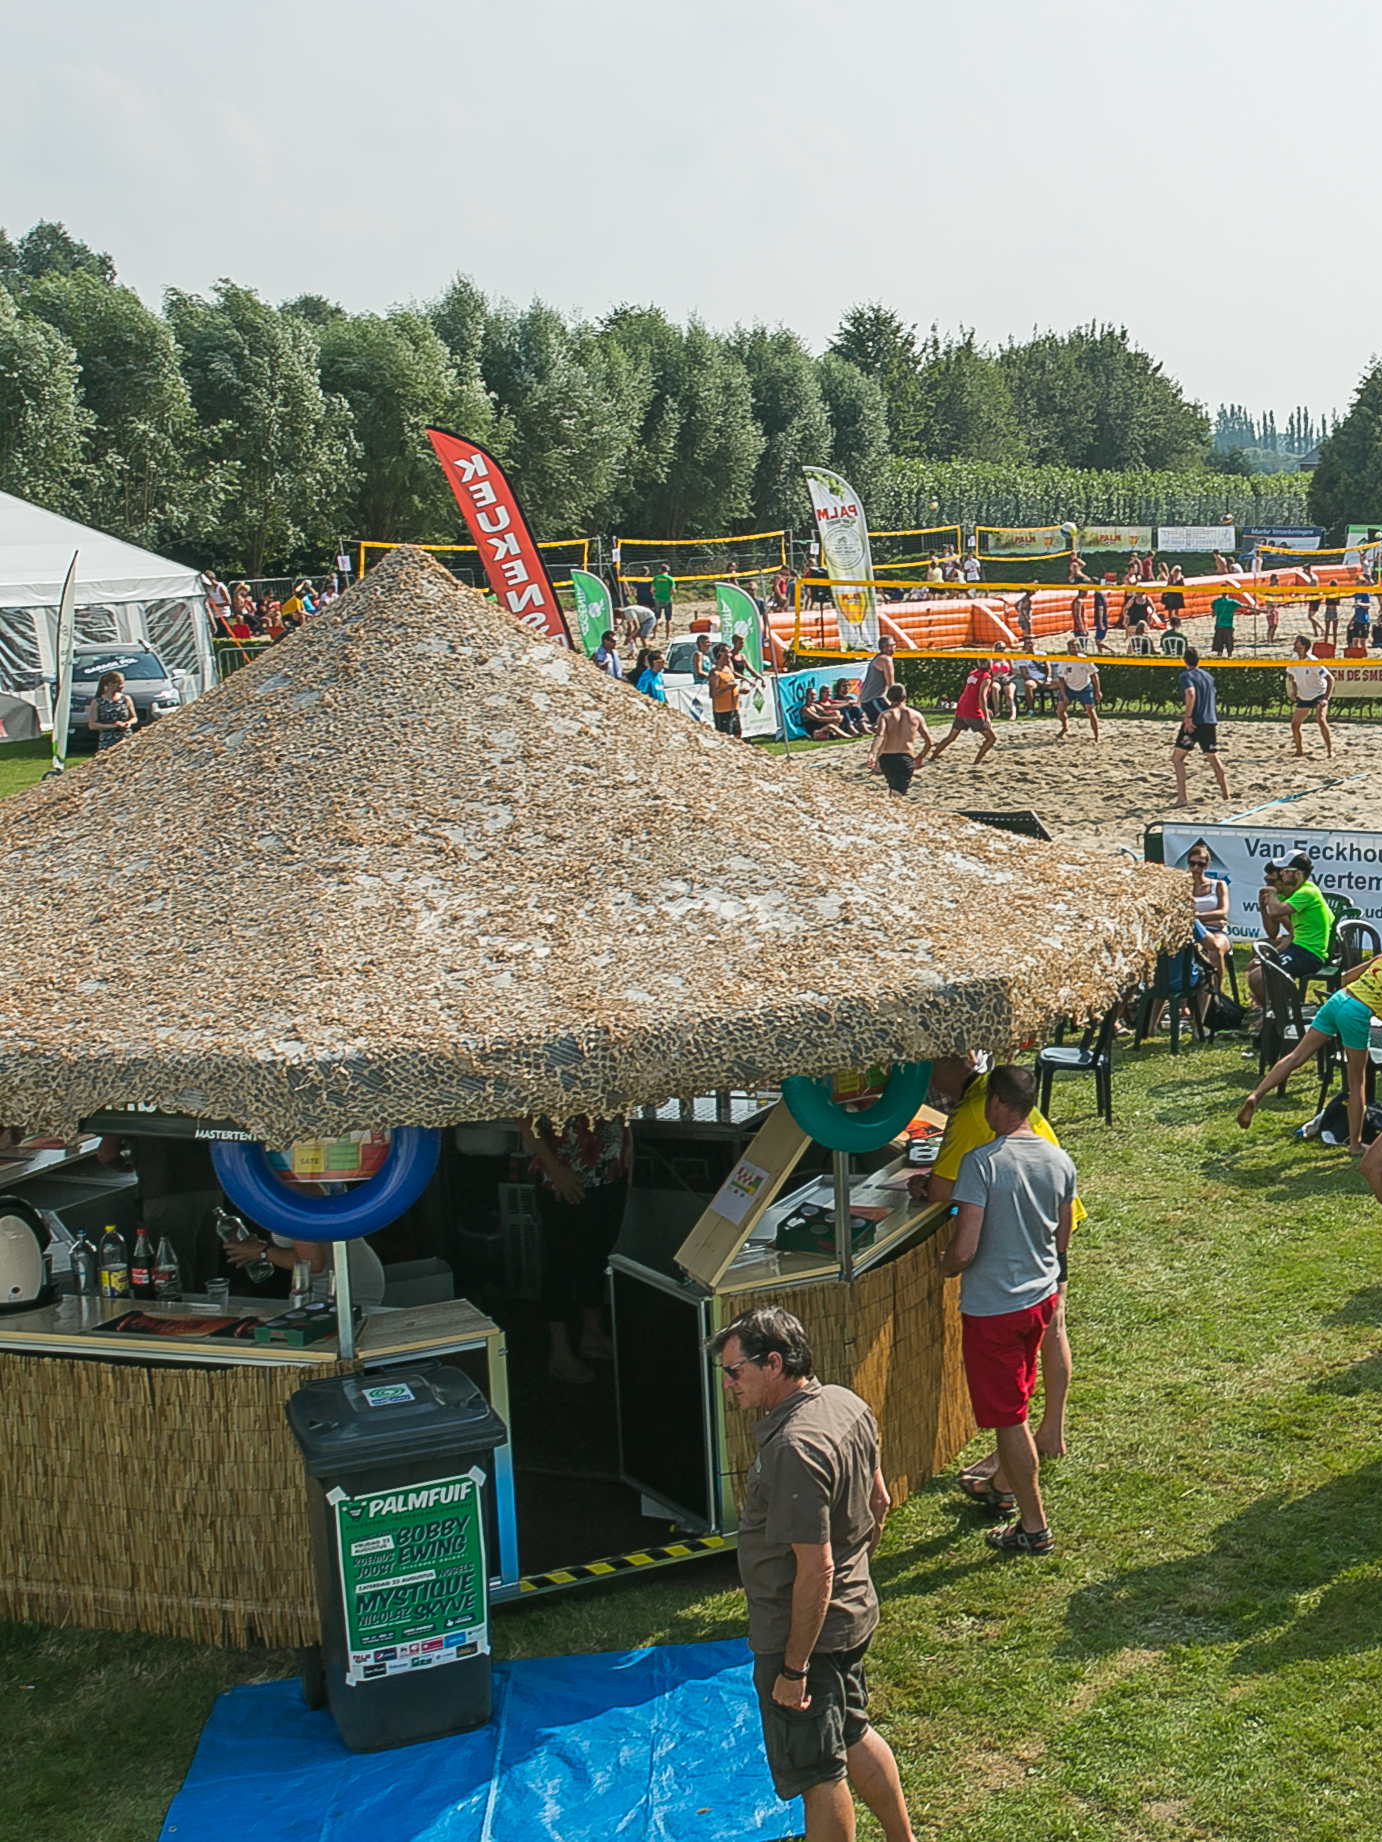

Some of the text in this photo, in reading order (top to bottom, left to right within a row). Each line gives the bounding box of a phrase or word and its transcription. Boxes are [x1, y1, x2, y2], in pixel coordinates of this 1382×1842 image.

[1099, 534, 1121, 542] PALM
[1347, 669, 1361, 682] DE
[1244, 838, 1286, 858] Van
[194, 1129, 258, 1142] MASTERTENT
[368, 1481, 473, 1518] PALMFUIF
[397, 1514, 471, 1547] BOBBY
[397, 1535, 467, 1566] EWING
[355, 1562, 396, 1579] JOOST
[358, 1580, 391, 1592] ZATERDAG
[402, 1572, 434, 1583] AUGUSTUS
[356, 1571, 476, 1615] MYSTIQUE
[414, 1592, 478, 1621] SKYVE
